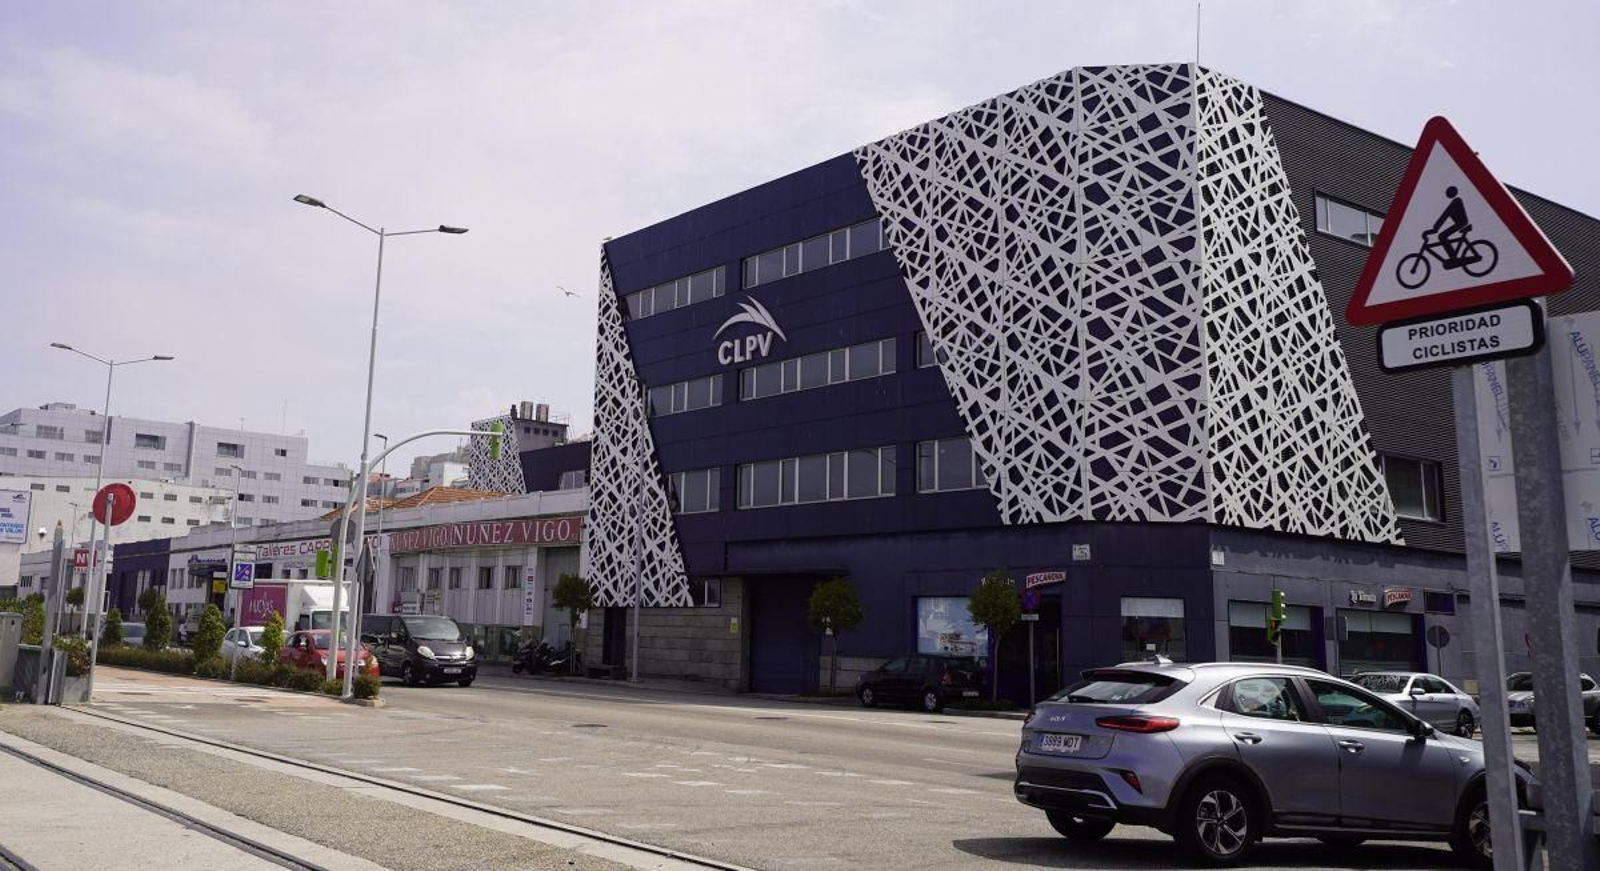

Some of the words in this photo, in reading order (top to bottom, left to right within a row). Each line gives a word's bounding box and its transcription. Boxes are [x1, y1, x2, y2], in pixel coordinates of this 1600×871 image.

[1408, 314, 1501, 341] PRIORIDAD
[718, 331, 774, 365] CLPV
[1412, 335, 1500, 359] CICLISTAS
[521, 519, 571, 542] VIGO
[257, 544, 296, 558] Talleres
